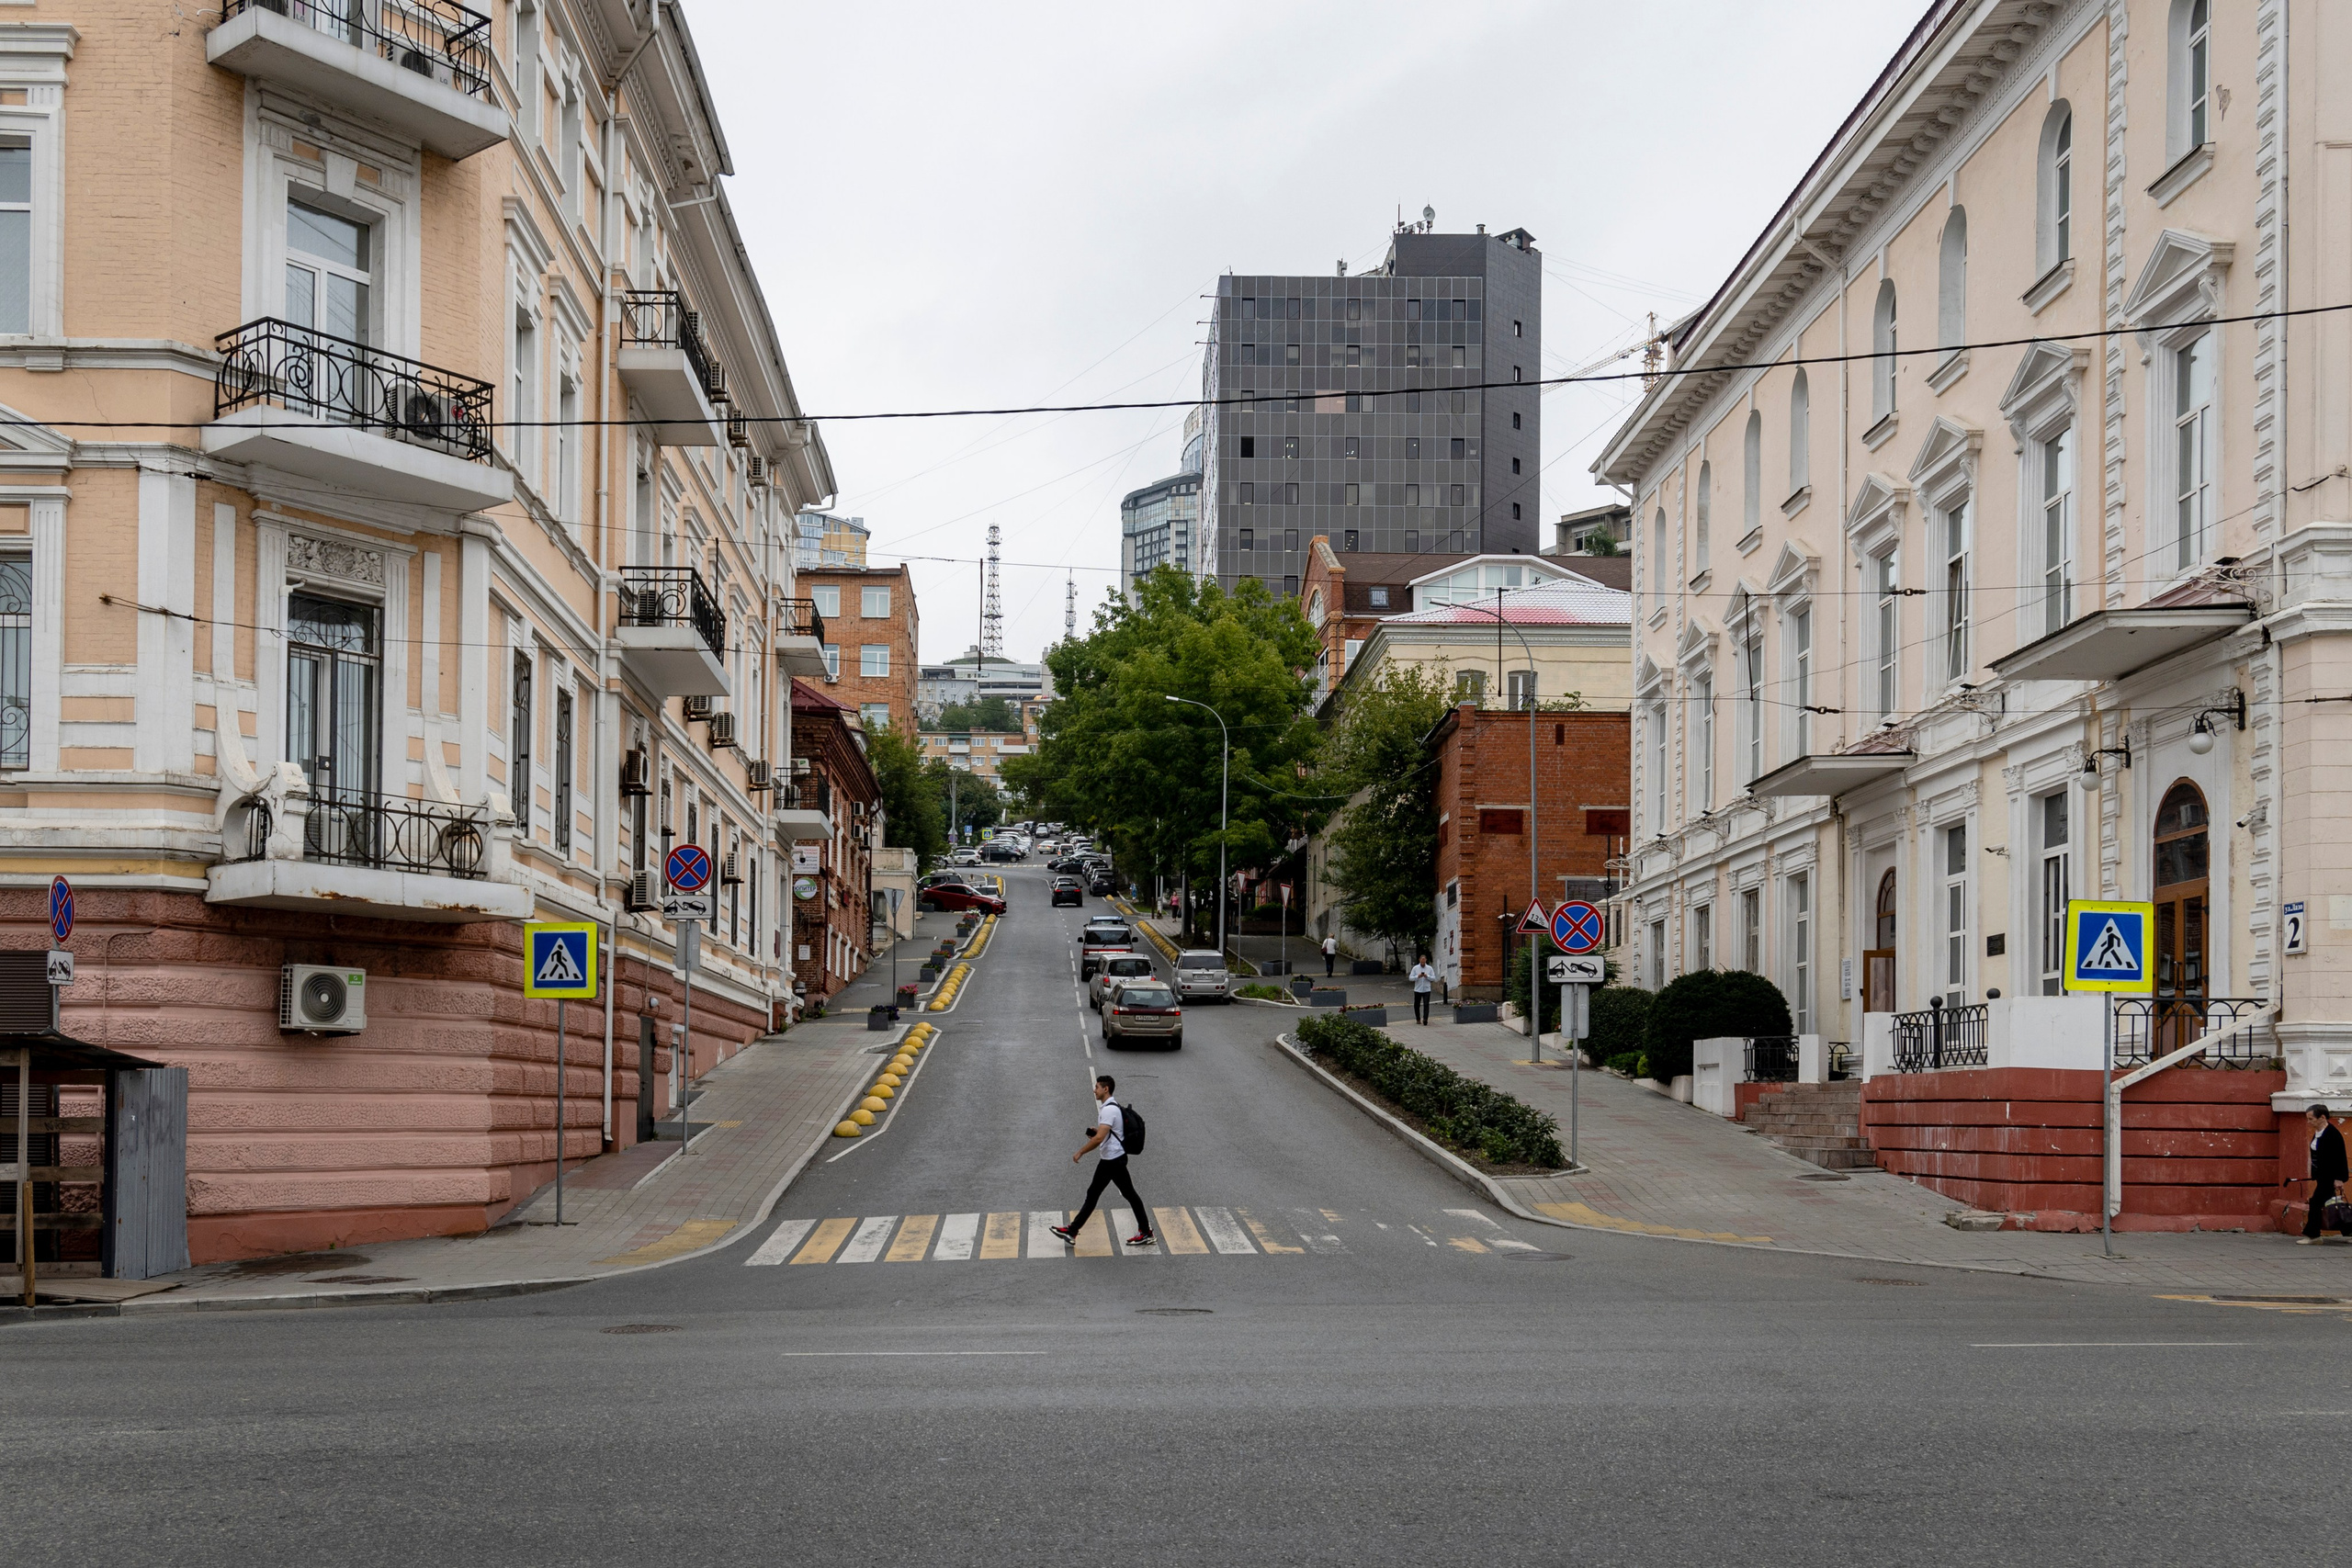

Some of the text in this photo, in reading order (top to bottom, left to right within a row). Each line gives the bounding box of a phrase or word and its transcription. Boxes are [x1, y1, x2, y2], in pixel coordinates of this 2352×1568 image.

[439, 77, 448, 85] LG
[1531, 913, 1545, 926] 13%
[2288, 917, 2301, 949] 2
